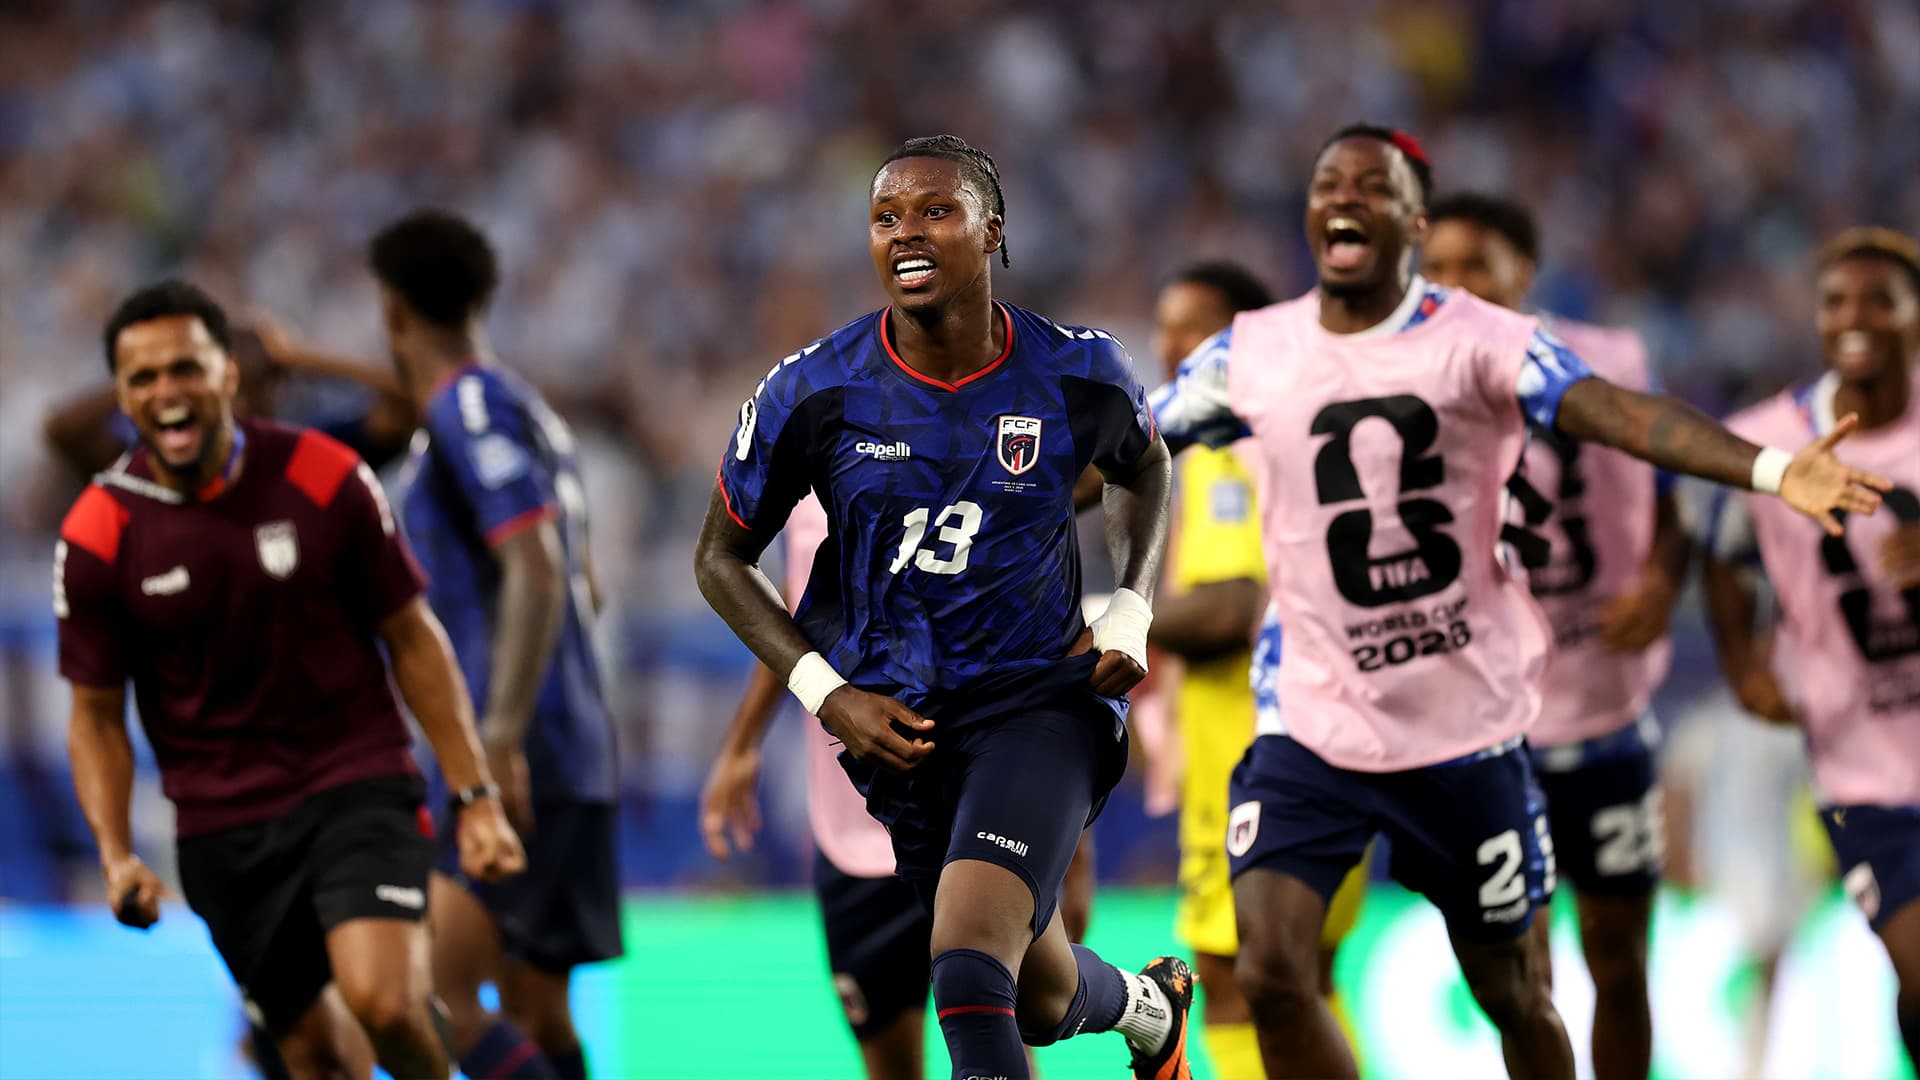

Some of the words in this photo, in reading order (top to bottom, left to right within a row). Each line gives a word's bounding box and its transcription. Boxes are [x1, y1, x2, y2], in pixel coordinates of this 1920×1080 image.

[1003, 419, 1038, 429] FCF
[855, 441, 911, 459] capelli
[888, 500, 984, 575] 13
[1368, 556, 1432, 592] FIFA
[1345, 611, 1427, 638] WORLD
[976, 831, 1029, 855] capelli
